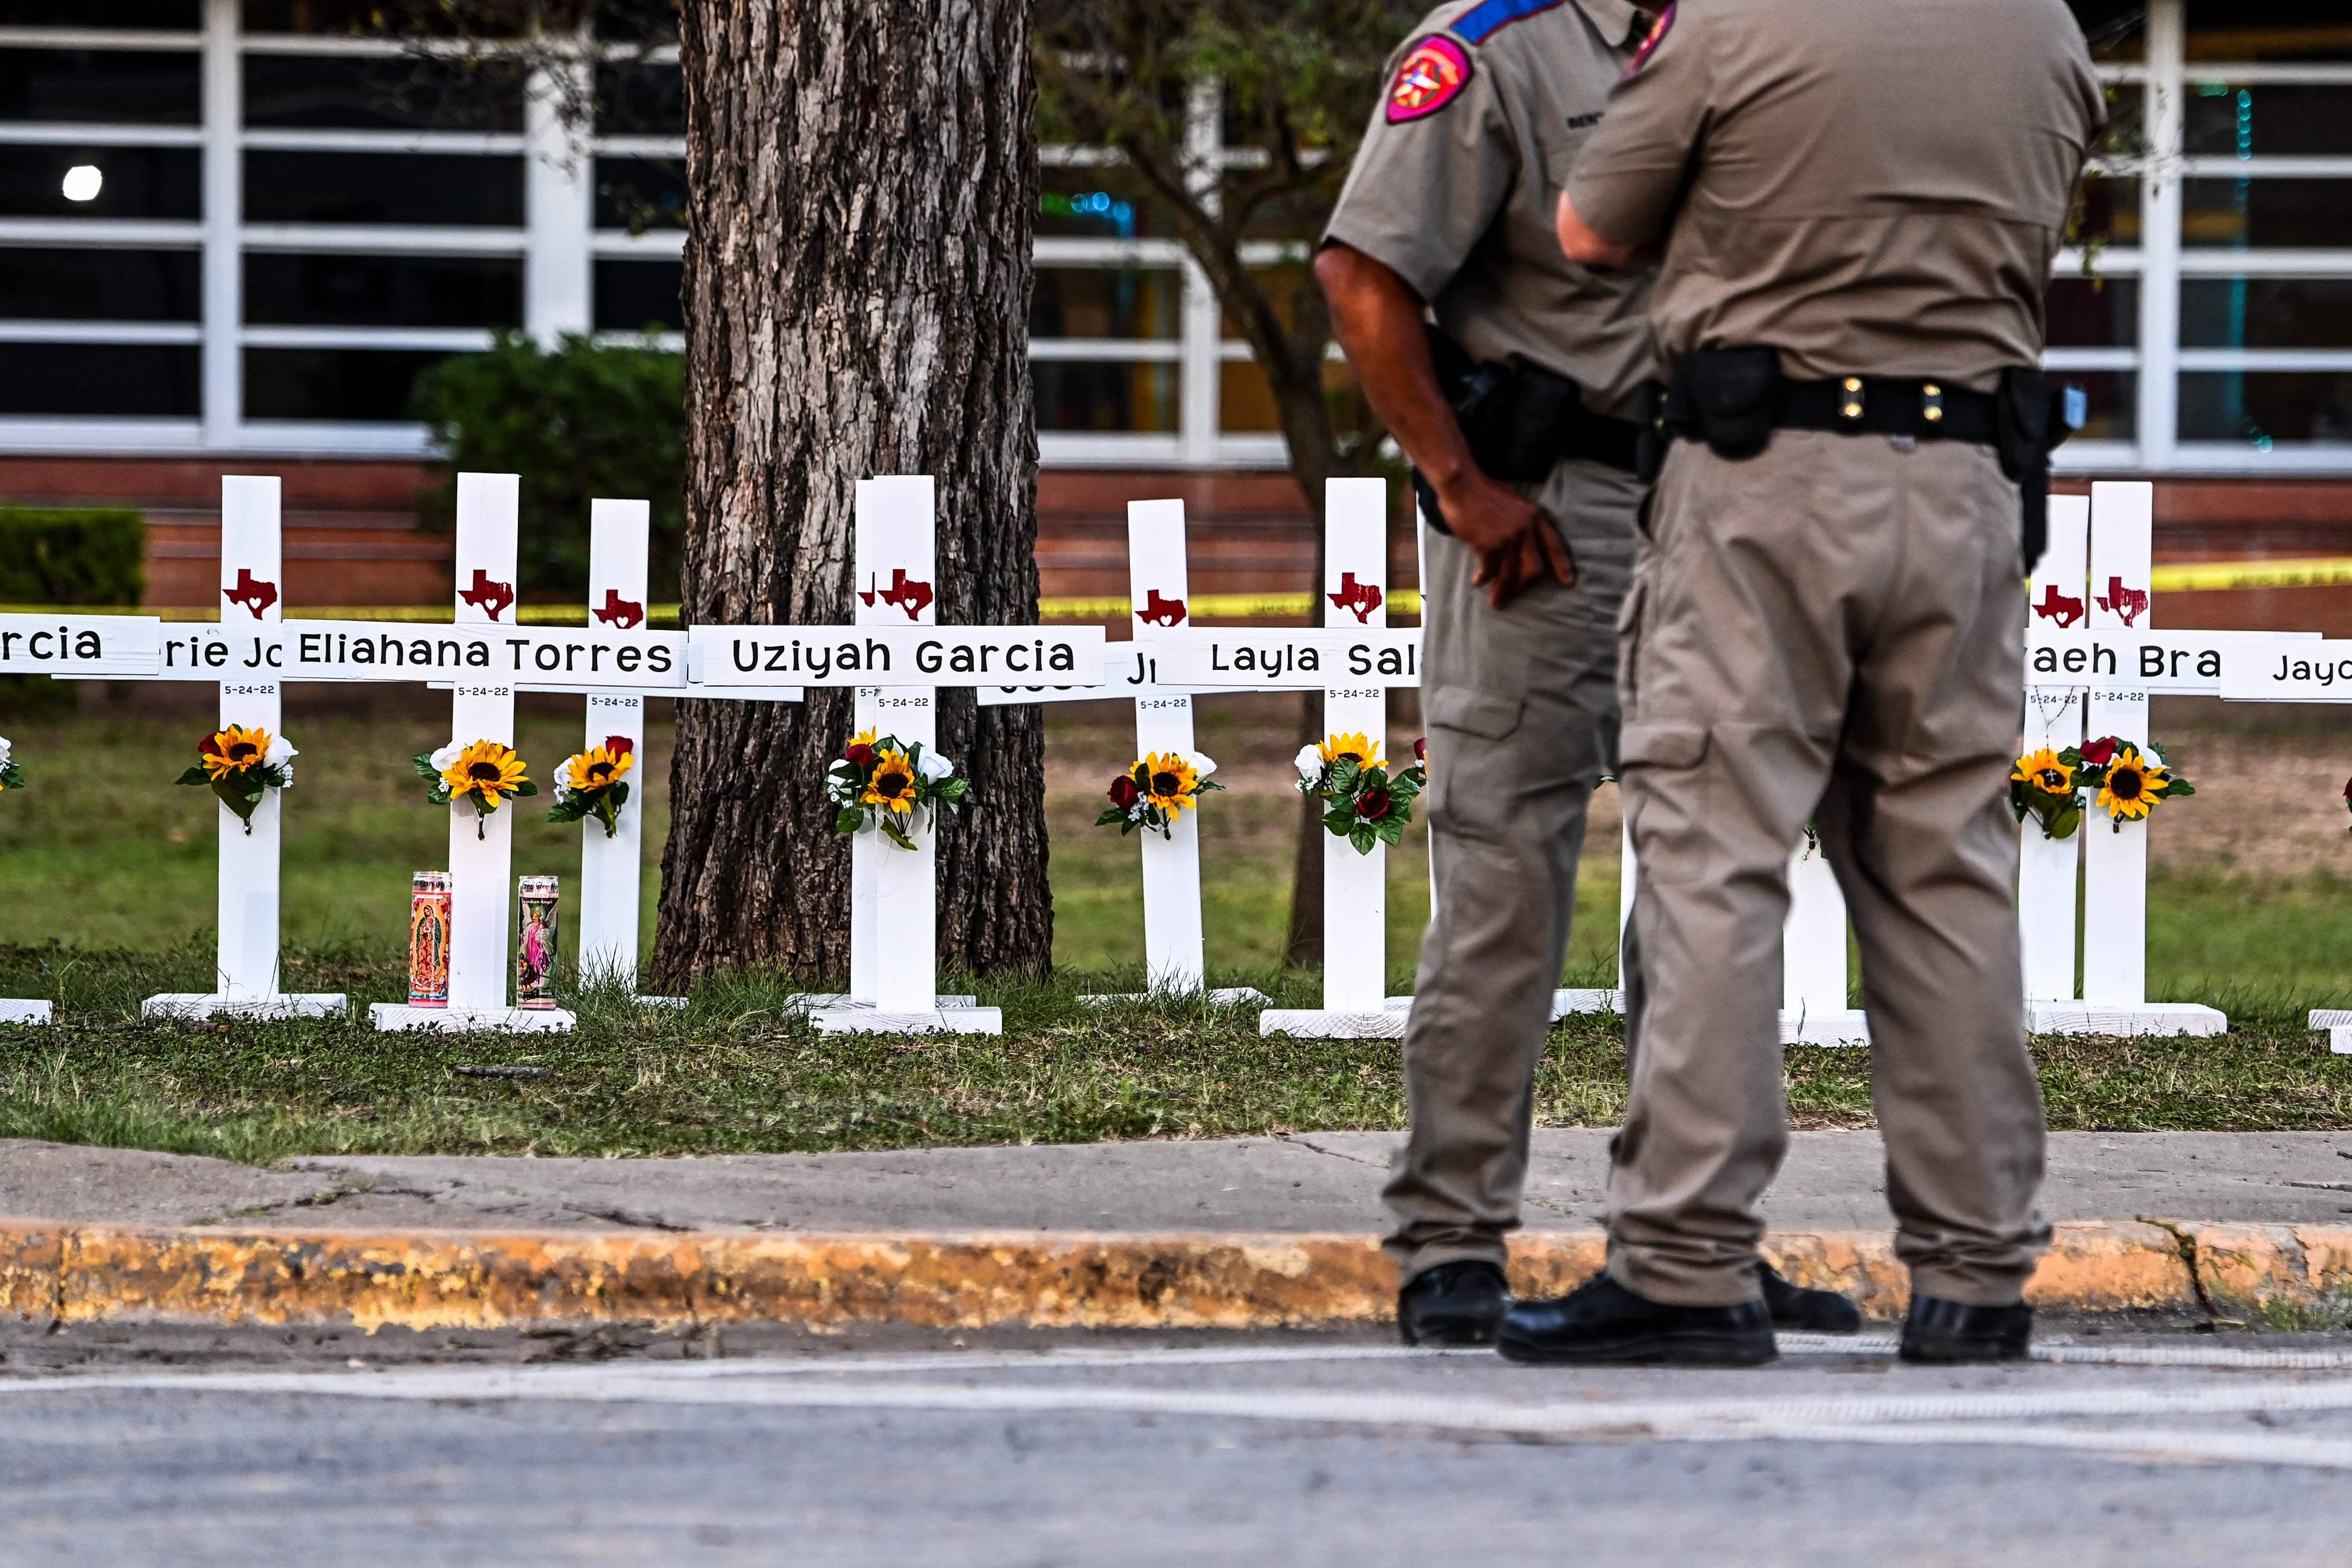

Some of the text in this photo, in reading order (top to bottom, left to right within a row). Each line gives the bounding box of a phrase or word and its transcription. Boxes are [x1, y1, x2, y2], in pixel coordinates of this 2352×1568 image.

[2, 625, 101, 660] rcia
[159, 630, 229, 667] rie
[300, 633, 672, 672] Eliahana Torres
[733, 638, 1074, 679] Uziyah Garcia
[1212, 643, 1423, 678] Layla Sal
[2024, 642, 2221, 677] aeh Bra
[225, 685, 274, 694] 5-24-22
[458, 687, 508, 696] 5-24-22
[1330, 689, 1379, 698] 5-24-22
[2030, 695, 2078, 704] 5-24-22
[2094, 692, 2144, 701] 5-24-22
[592, 697, 638, 707] 5-24-22
[879, 698, 929, 707] 5-24-22
[1140, 699, 1187, 709] 5-24-22
